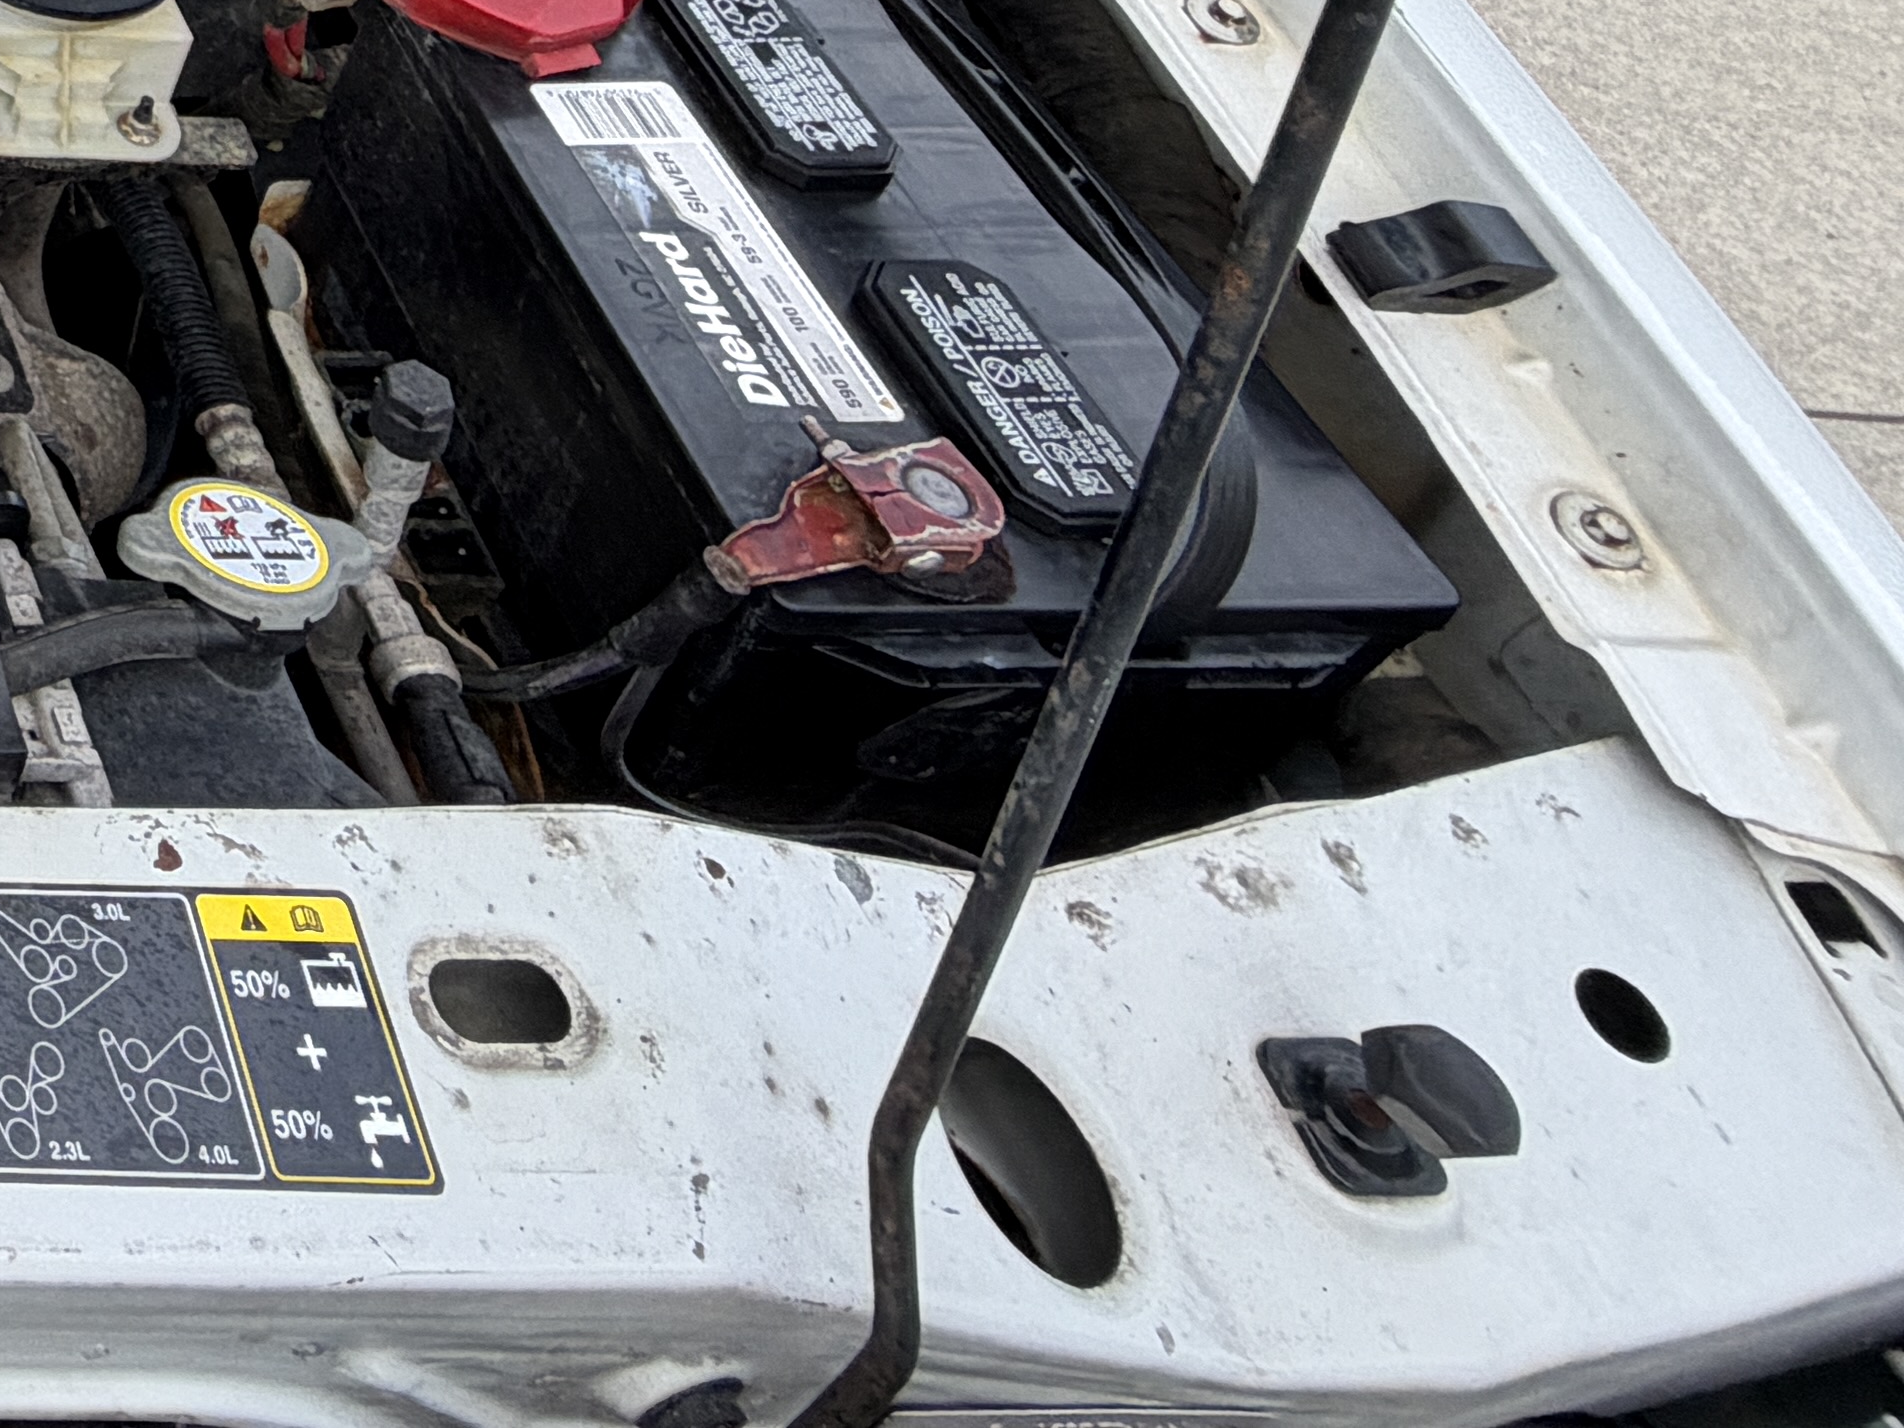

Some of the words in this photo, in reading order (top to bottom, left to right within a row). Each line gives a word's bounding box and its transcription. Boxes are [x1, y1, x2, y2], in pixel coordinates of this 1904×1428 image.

[653, 151, 709, 215] SILVER
[639, 230, 791, 407] DieHard
[781, 306, 809, 333] 100
[900, 289, 964, 360] POISON
[831, 378, 863, 408] 590
[966, 380, 1041, 465] DANGER
[91, 903, 131, 921] 3.0L
[230, 970, 291, 999] 50%
[270, 1109, 333, 1140] 50%
[49, 1141, 91, 1162] 2.3L
[199, 1145, 239, 1165] 4.0L
